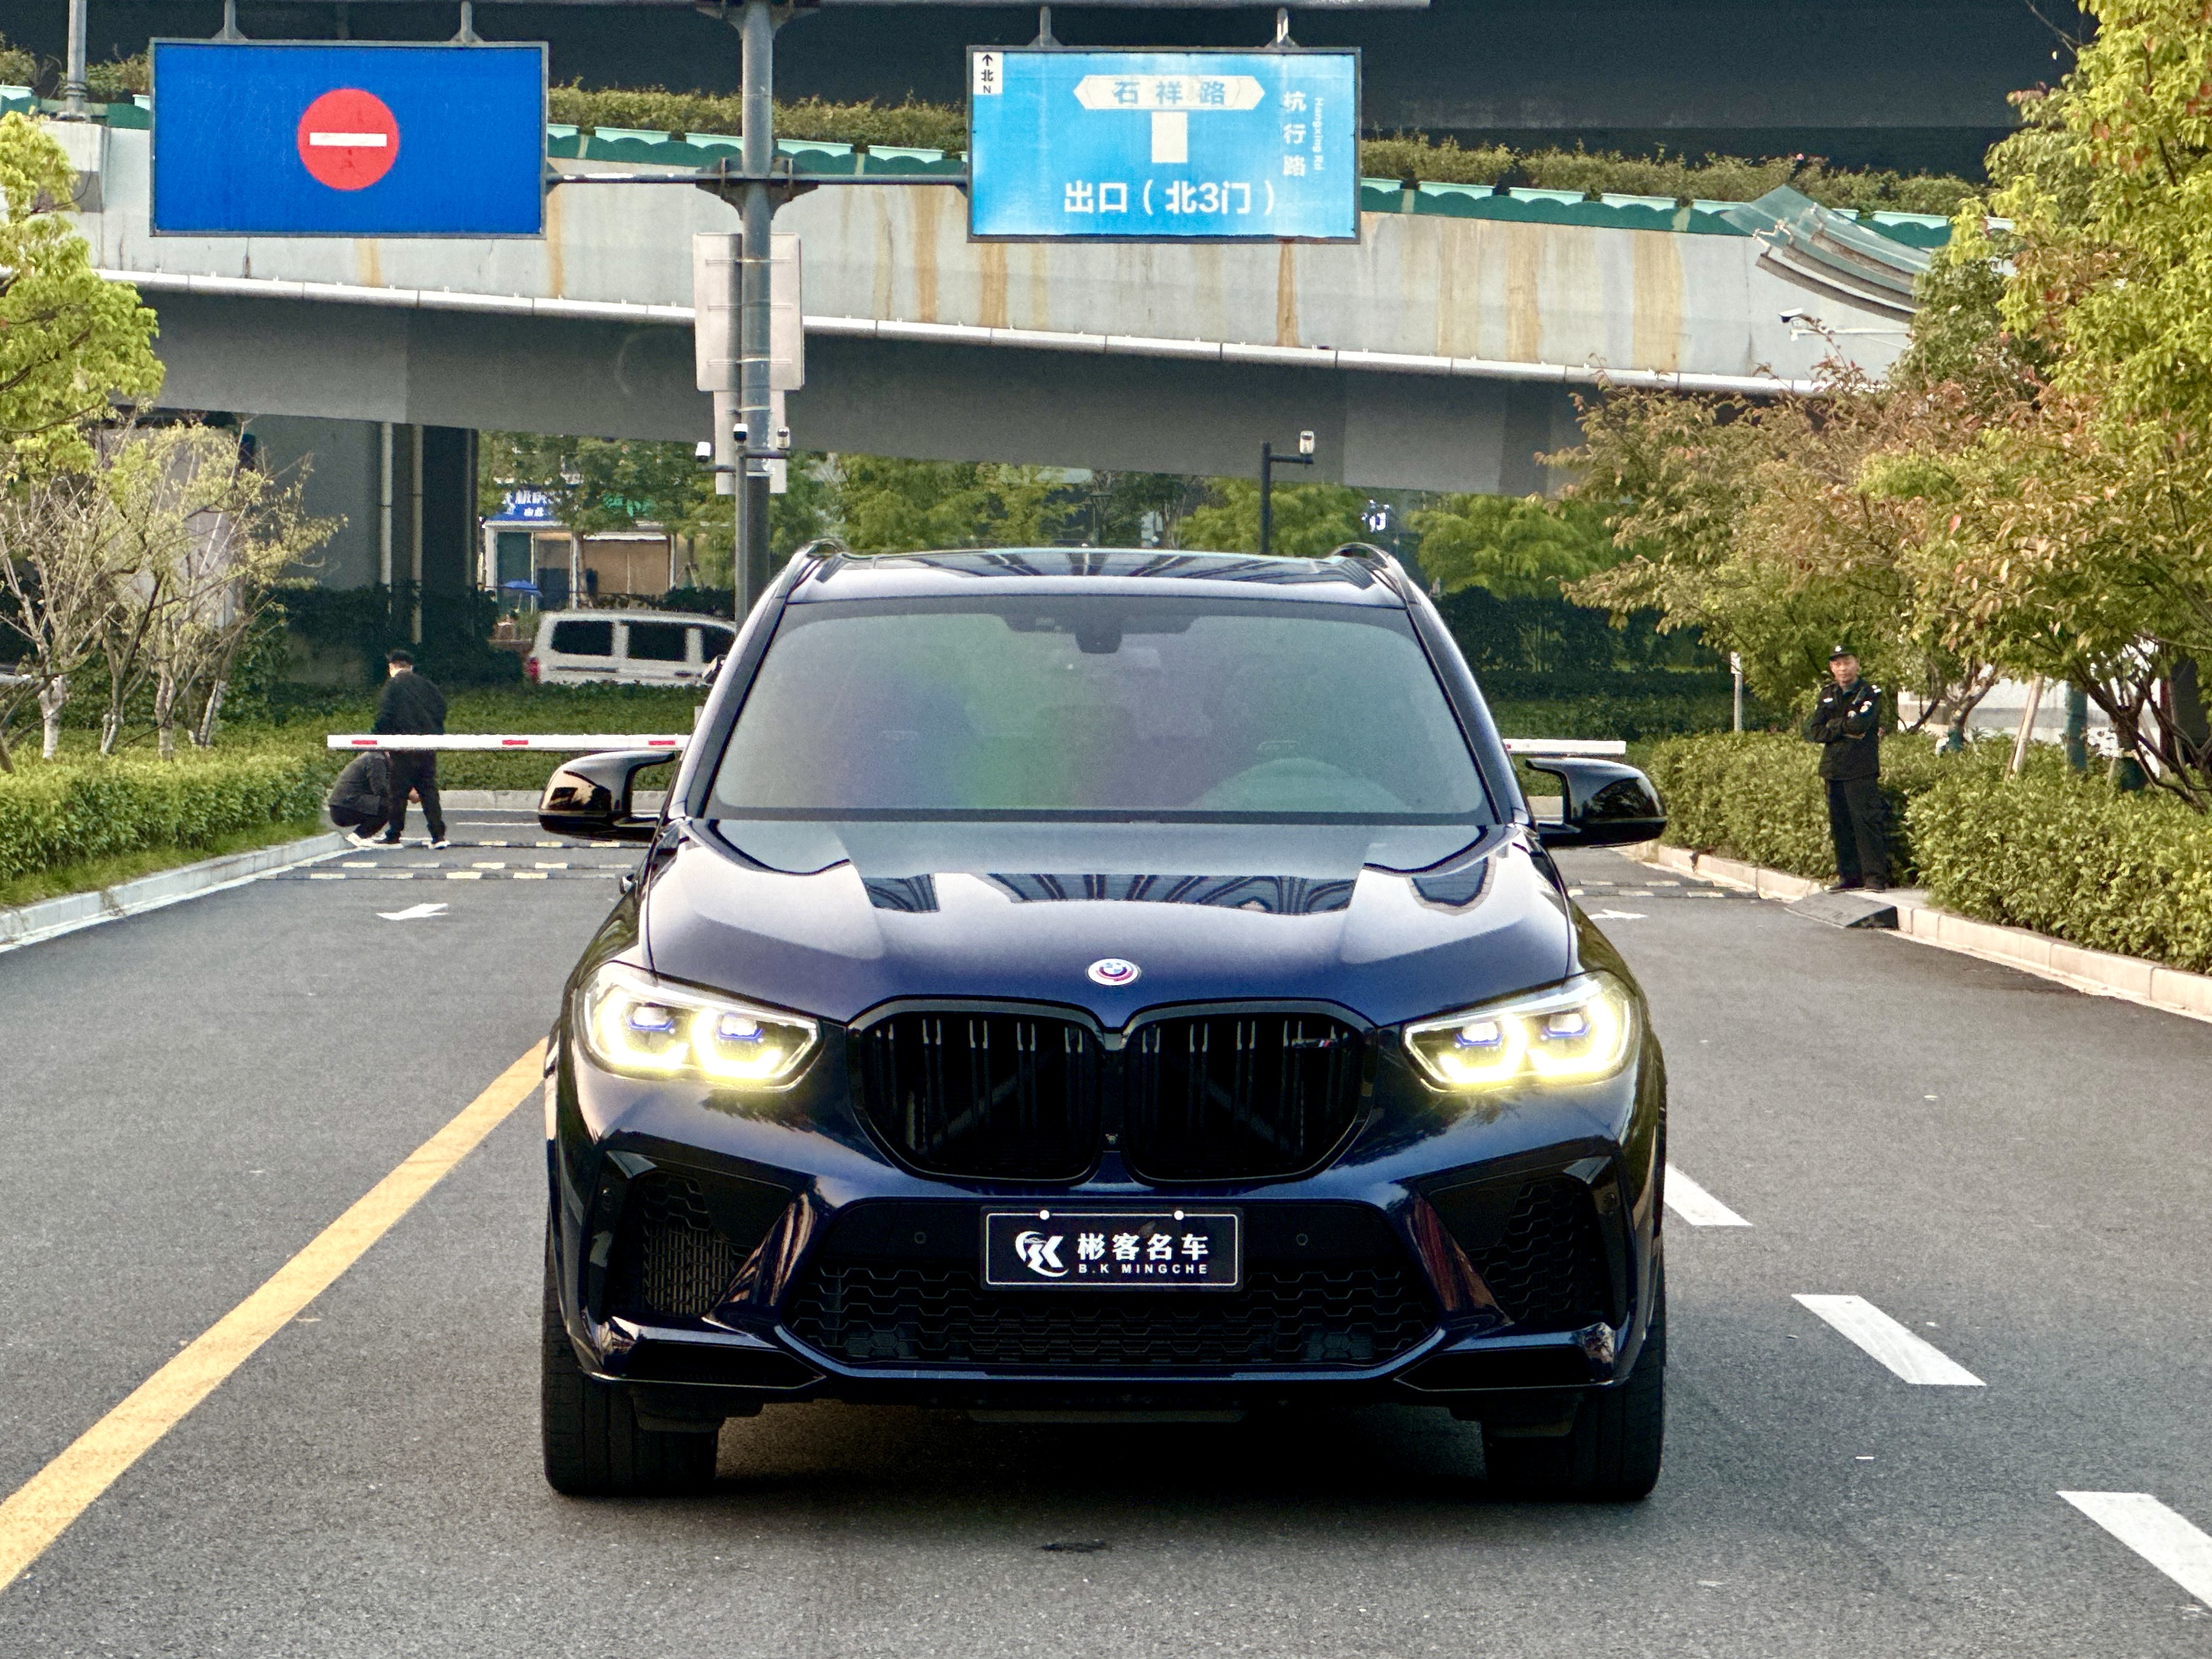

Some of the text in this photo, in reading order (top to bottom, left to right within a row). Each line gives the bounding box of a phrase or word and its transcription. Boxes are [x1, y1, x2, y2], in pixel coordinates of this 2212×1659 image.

[981, 69, 994, 81] 北
[983, 85, 991, 94] N
[1112, 81, 1225, 105] 石祥路
[1283, 91, 1306, 176] 杭行路
[1313, 97, 1324, 171] Hangxing Rd
[1077, 1233, 1209, 1260] 彬客名车
[1079, 1263, 1208, 1273] B.K MINGCHE
